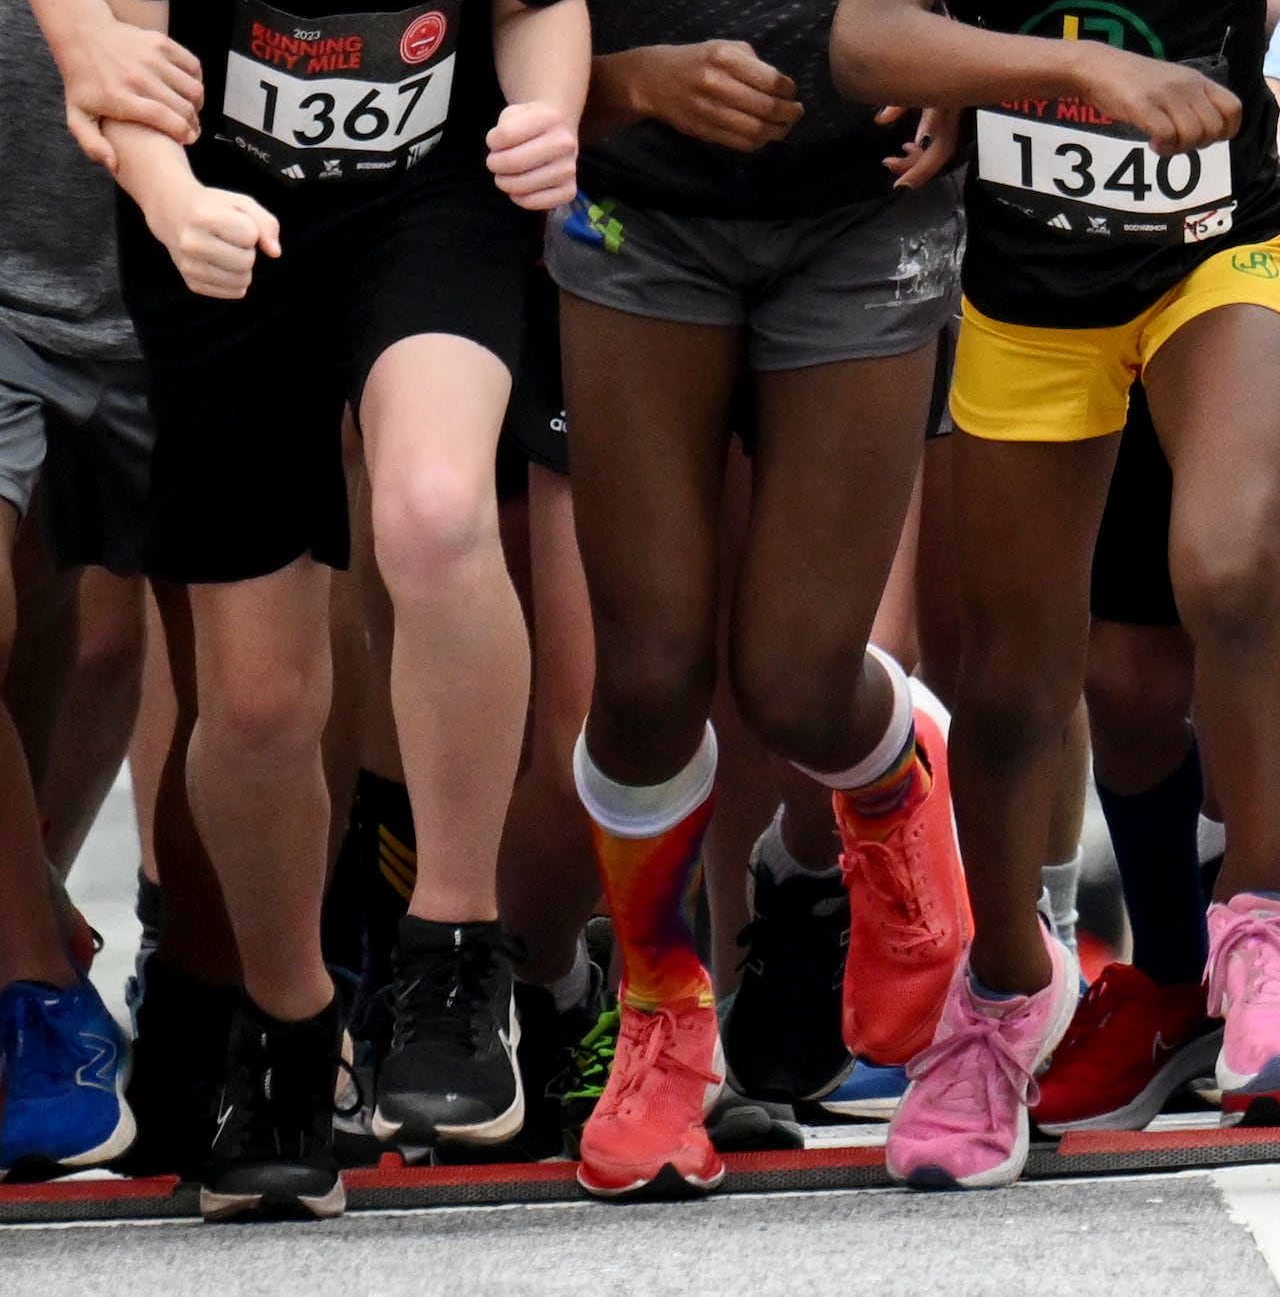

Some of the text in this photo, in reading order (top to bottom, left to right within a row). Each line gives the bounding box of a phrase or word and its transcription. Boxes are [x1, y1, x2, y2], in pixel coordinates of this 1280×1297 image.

[251, 21, 364, 53] RUNNING
[293, 27, 322, 41] 2023
[251, 39, 363, 75] CITY MILE
[259, 72, 434, 147] 1367
[247, 143, 271, 164] PNC
[1012, 132, 1202, 202] 1340
